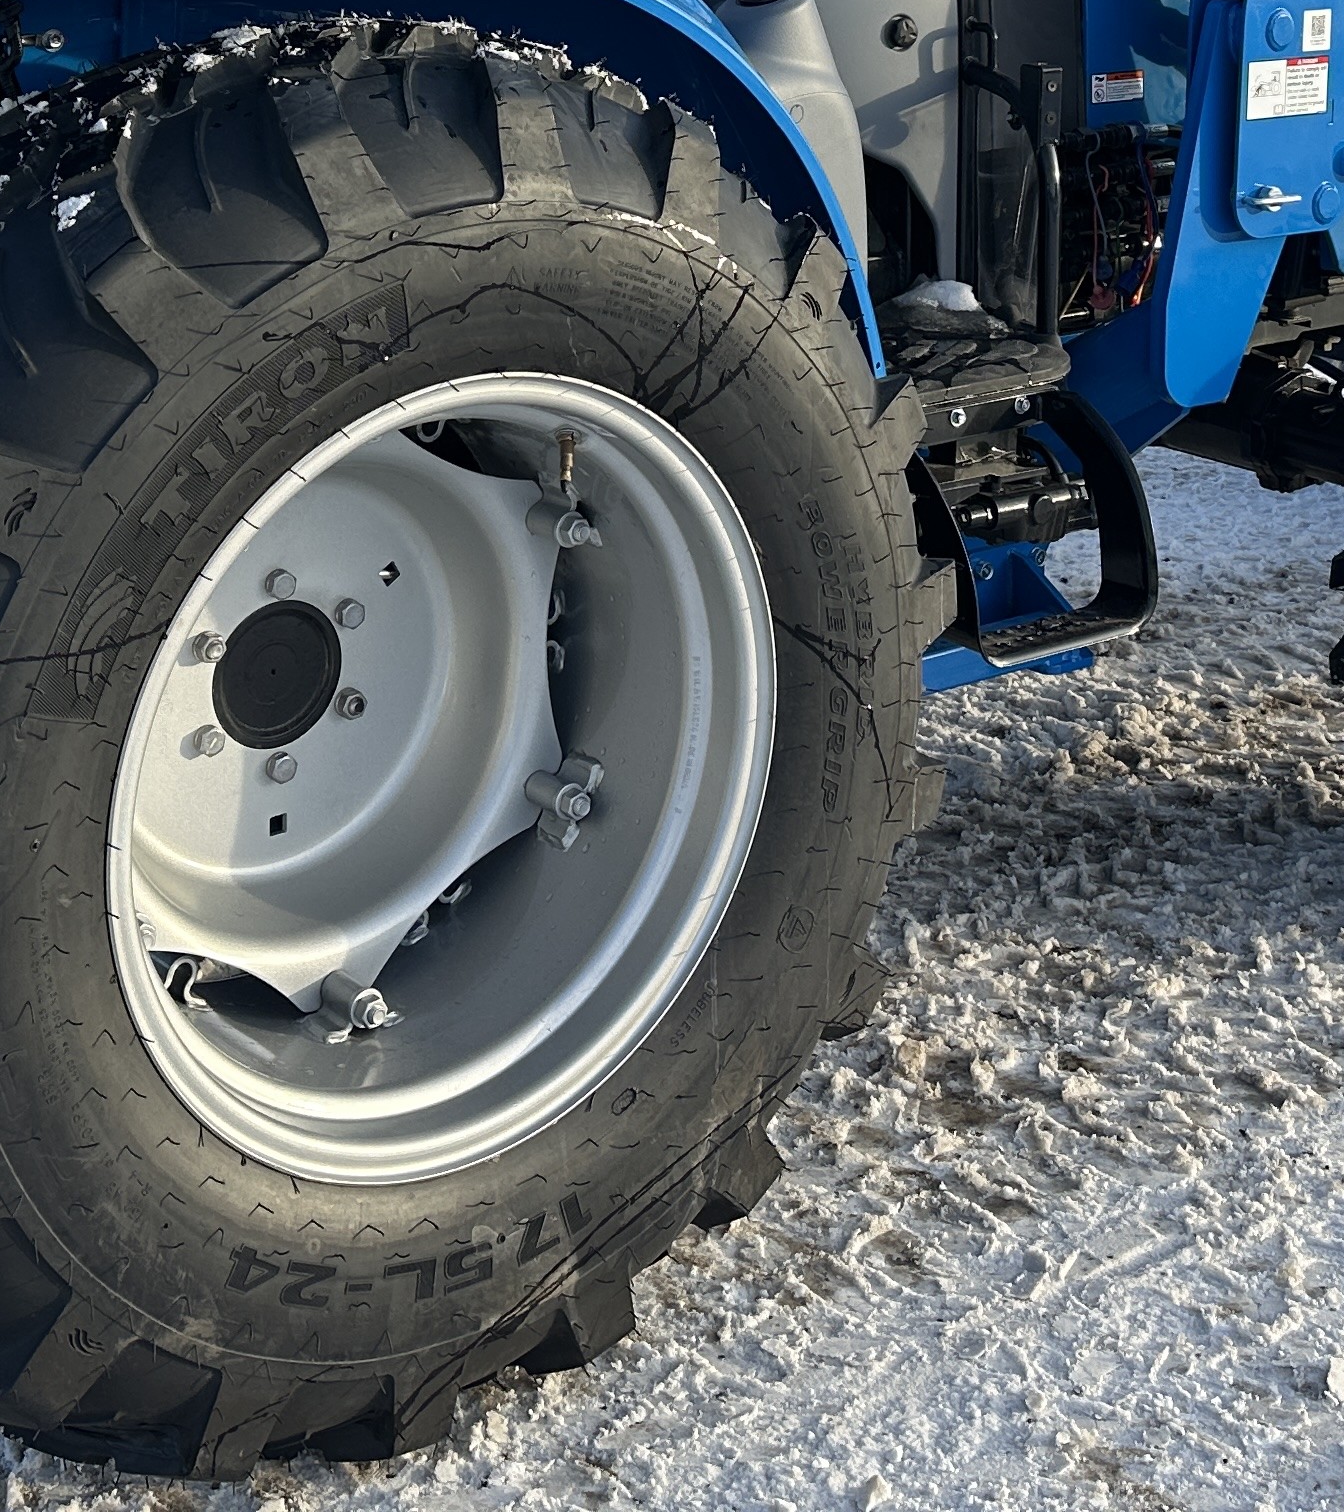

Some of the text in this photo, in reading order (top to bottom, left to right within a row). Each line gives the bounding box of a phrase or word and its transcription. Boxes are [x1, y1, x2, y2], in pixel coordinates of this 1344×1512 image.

[139, 305, 392, 527] TIRON
[821, 687, 848, 813] GRIP
[224, 1191, 593, 1308] 17.5L-24
